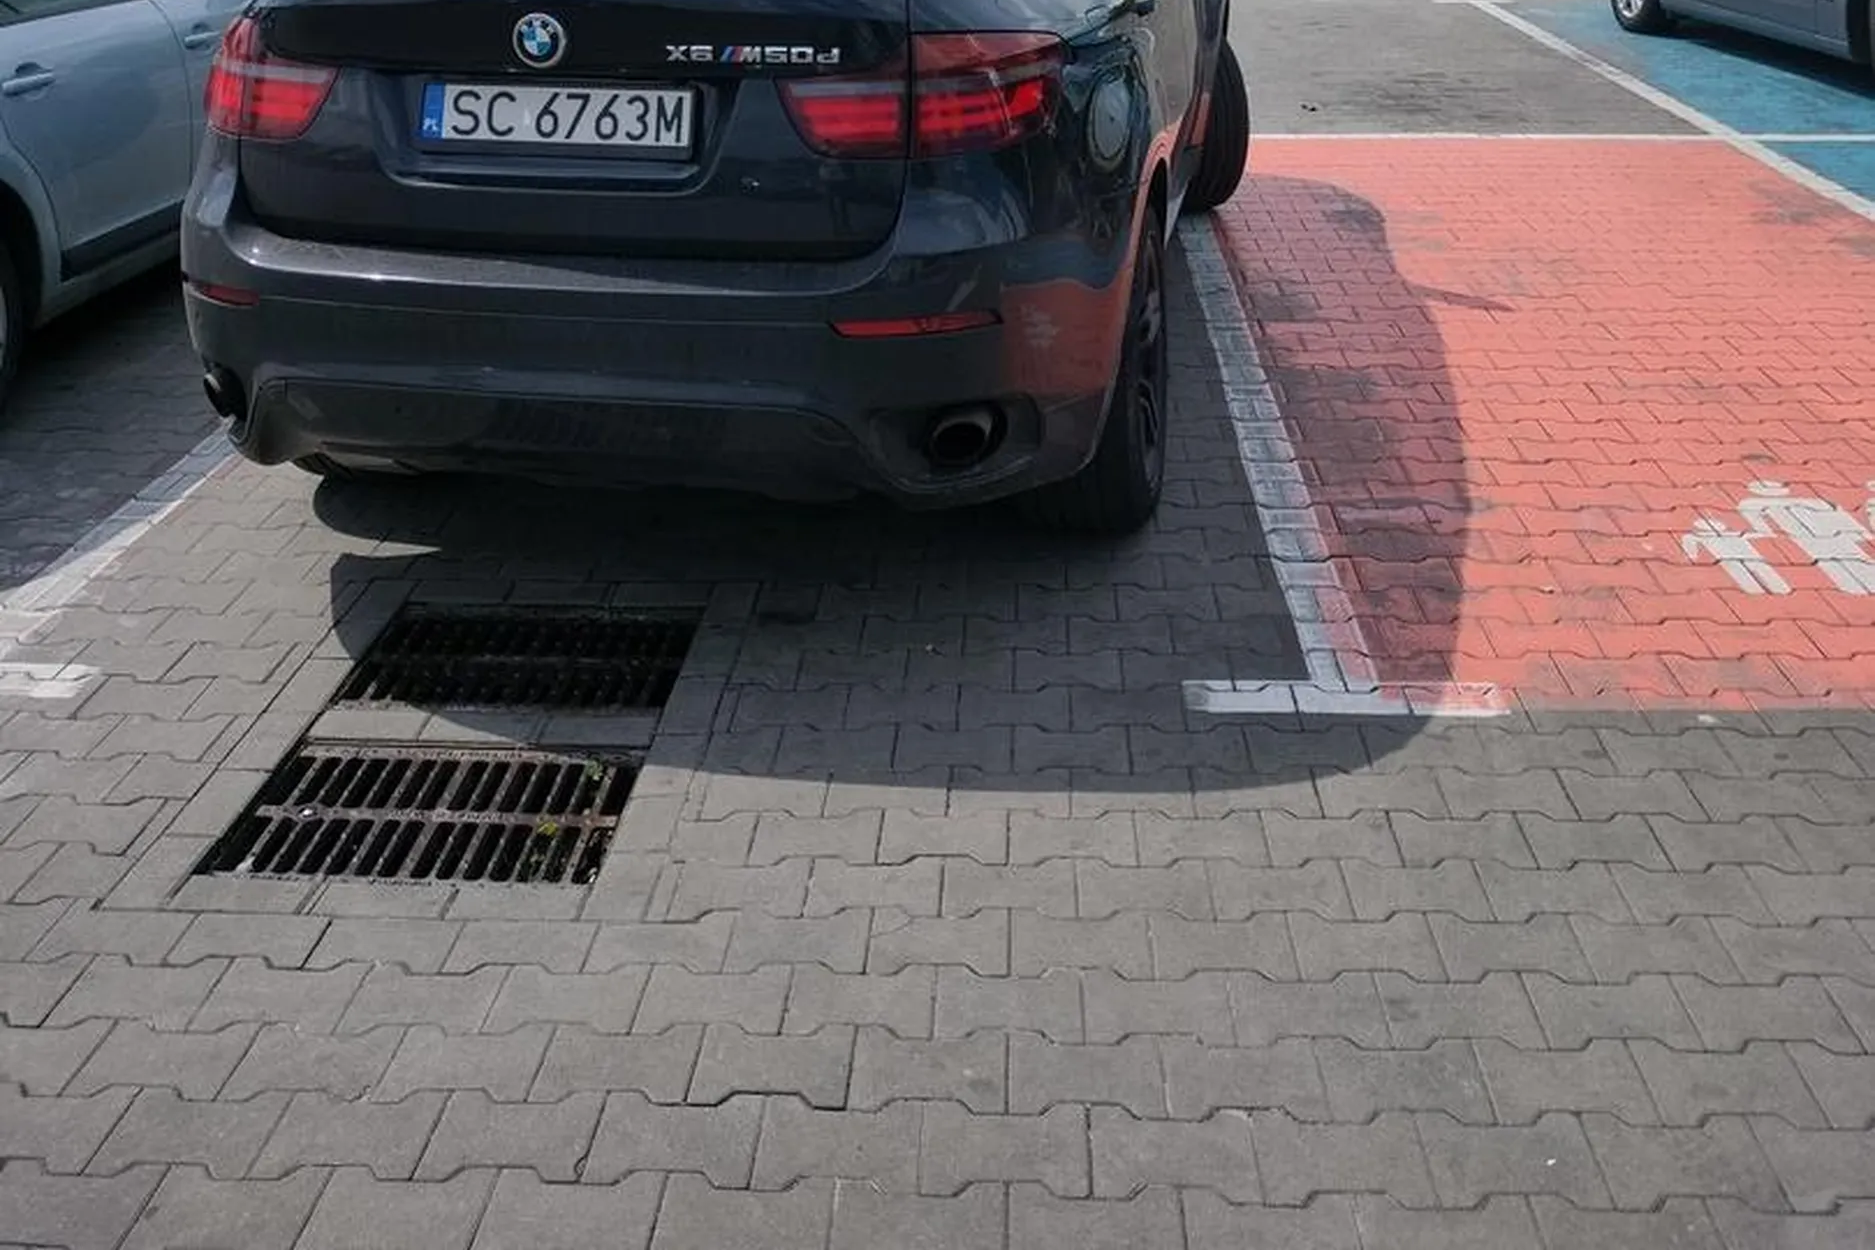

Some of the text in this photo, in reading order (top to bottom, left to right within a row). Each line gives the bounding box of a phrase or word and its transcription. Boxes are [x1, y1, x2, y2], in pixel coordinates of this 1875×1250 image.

[665, 44, 714, 63] X6
[451, 89, 685, 144] SC 6763M
